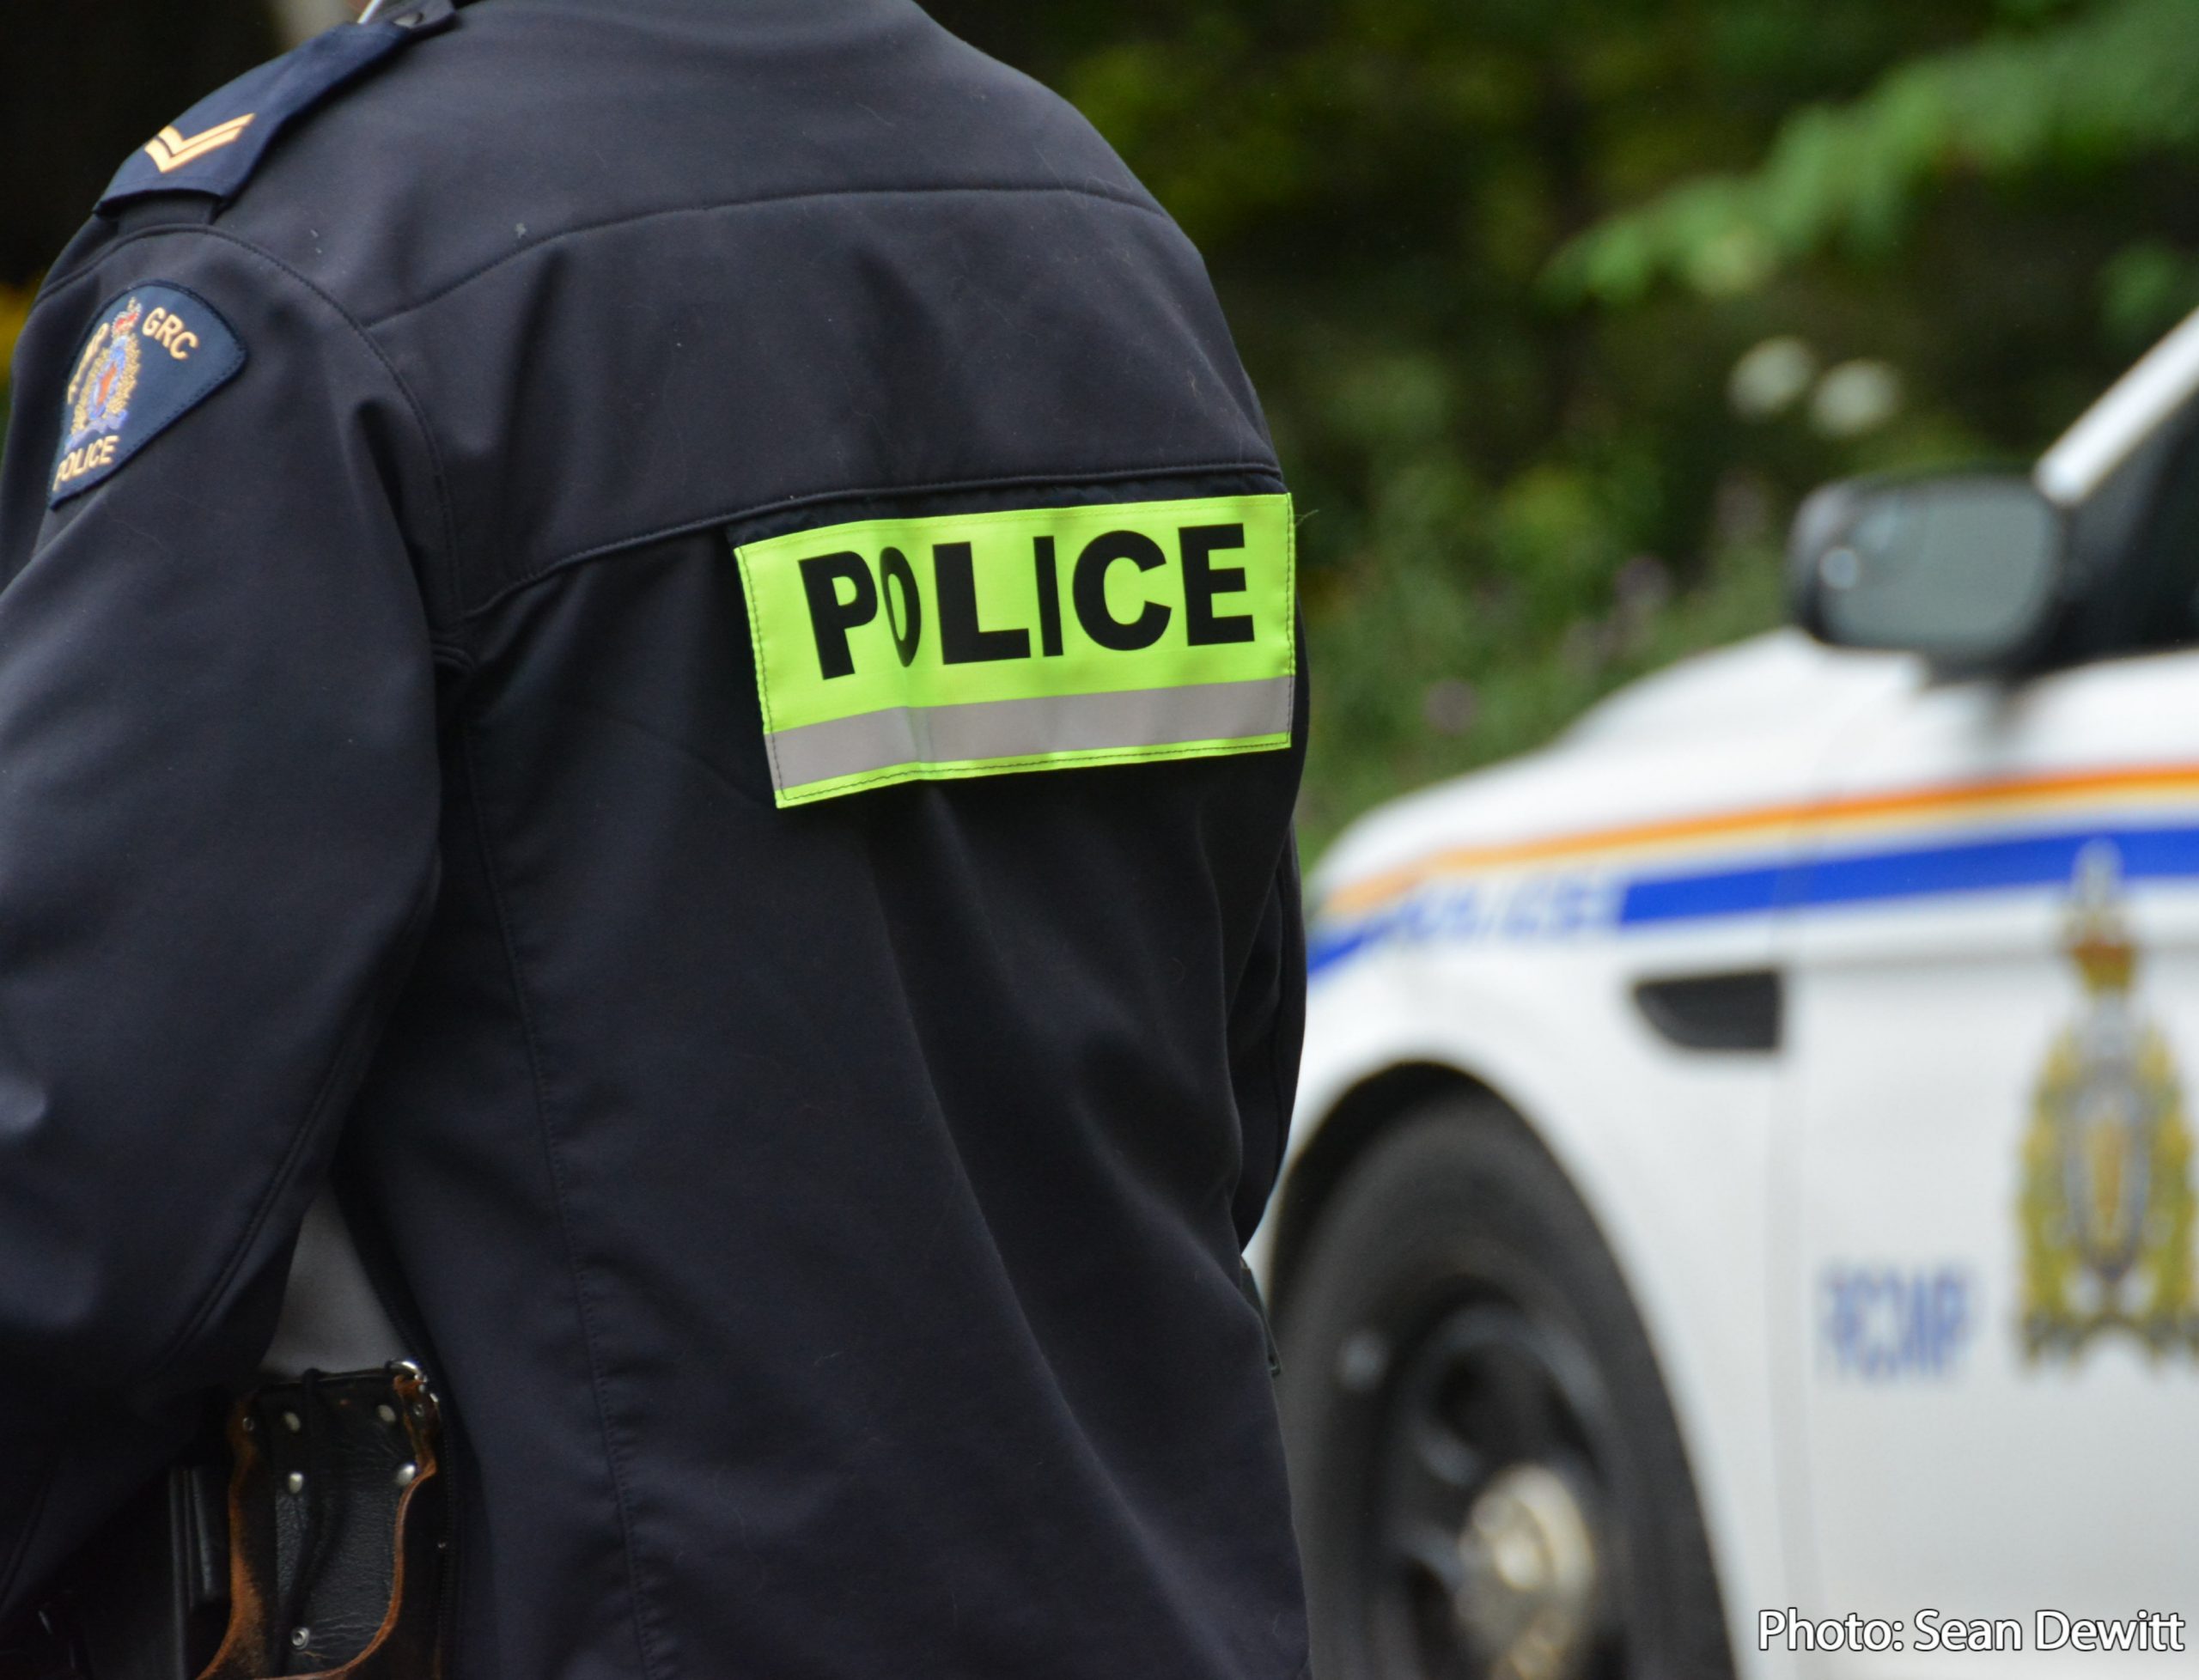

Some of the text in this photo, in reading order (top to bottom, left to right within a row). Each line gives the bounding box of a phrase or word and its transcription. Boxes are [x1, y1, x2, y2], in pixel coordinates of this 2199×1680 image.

[142, 307, 199, 361] GRC
[52, 435, 120, 492] POLICE
[798, 522, 1255, 680] POLICE
